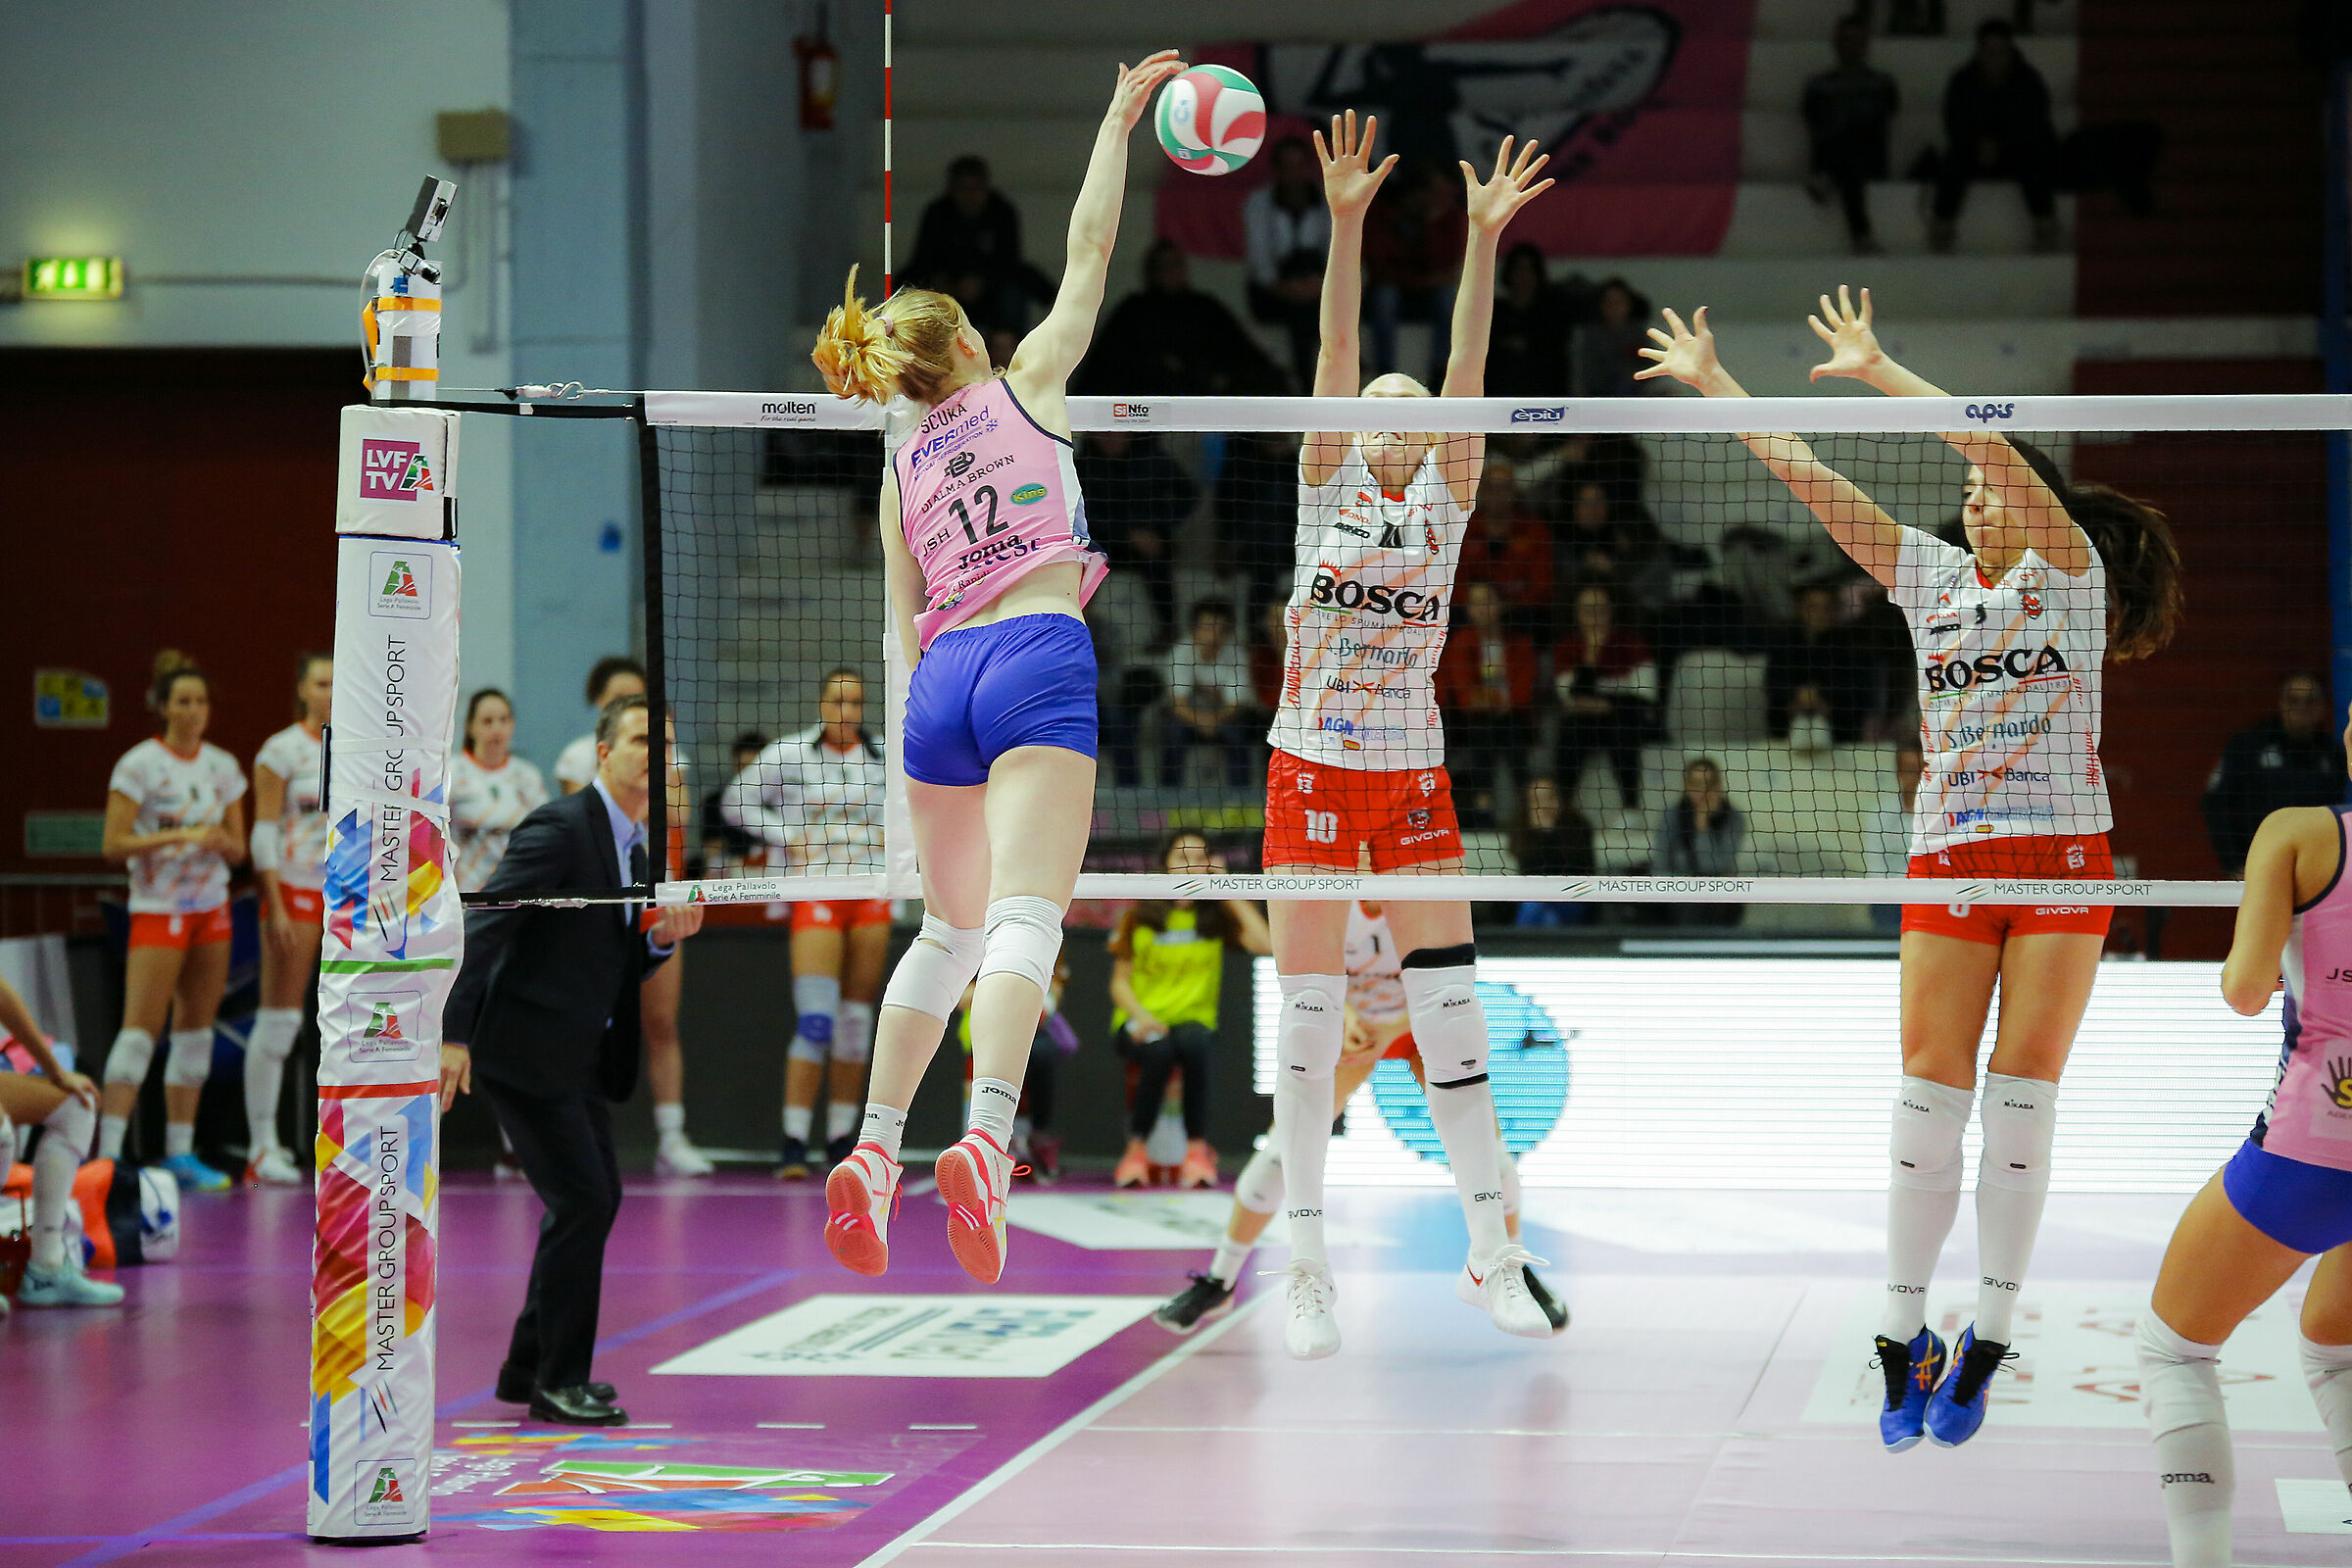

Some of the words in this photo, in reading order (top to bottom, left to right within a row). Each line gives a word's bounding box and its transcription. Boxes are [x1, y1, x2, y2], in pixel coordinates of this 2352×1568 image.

[761, 401, 815, 414] molten
[1965, 403, 2015, 423] apis
[921, 404, 967, 434] SCUKA
[366, 449, 408, 469] LVF
[365, 470, 399, 490] TV
[920, 480, 966, 514] DIALMA
[966, 454, 1016, 484] BROWN
[948, 484, 1009, 546] 12
[923, 527, 951, 557] JSH
[1309, 572, 1441, 622] BOSCA
[385, 634, 406, 708] SPORT
[1925, 644, 2070, 693] BOSCA
[1326, 675, 1350, 694] UBI
[1375, 683, 1411, 700] Banca
[1947, 771, 1975, 787] UBI
[2006, 767, 2050, 783] Banca
[1304, 808, 1339, 845] 10
[712, 883, 733, 893] Lega
[737, 882, 777, 891] Pallavolo
[1209, 879, 1262, 890] MASTER
[1266, 879, 1316, 890] GROUP
[1318, 879, 1362, 890] SPORT
[1598, 881, 1652, 893] MASTER
[1655, 881, 1706, 893] GROUP
[1708, 881, 1754, 893] SPORT
[1993, 883, 2050, 896] MASTER
[2052, 883, 2104, 896] GROUP
[2106, 884, 2152, 896] SPORT
[730, 892, 737, 902] A
[739, 891, 781, 901] Femminile
[1295, 1002, 1324, 1012] MIKASA
[1443, 999, 1471, 1009] MIKASA
[379, 1125, 399, 1197] SPORT
[377, 1200, 397, 1280] GROUP
[376, 1283, 396, 1371] MASTER
